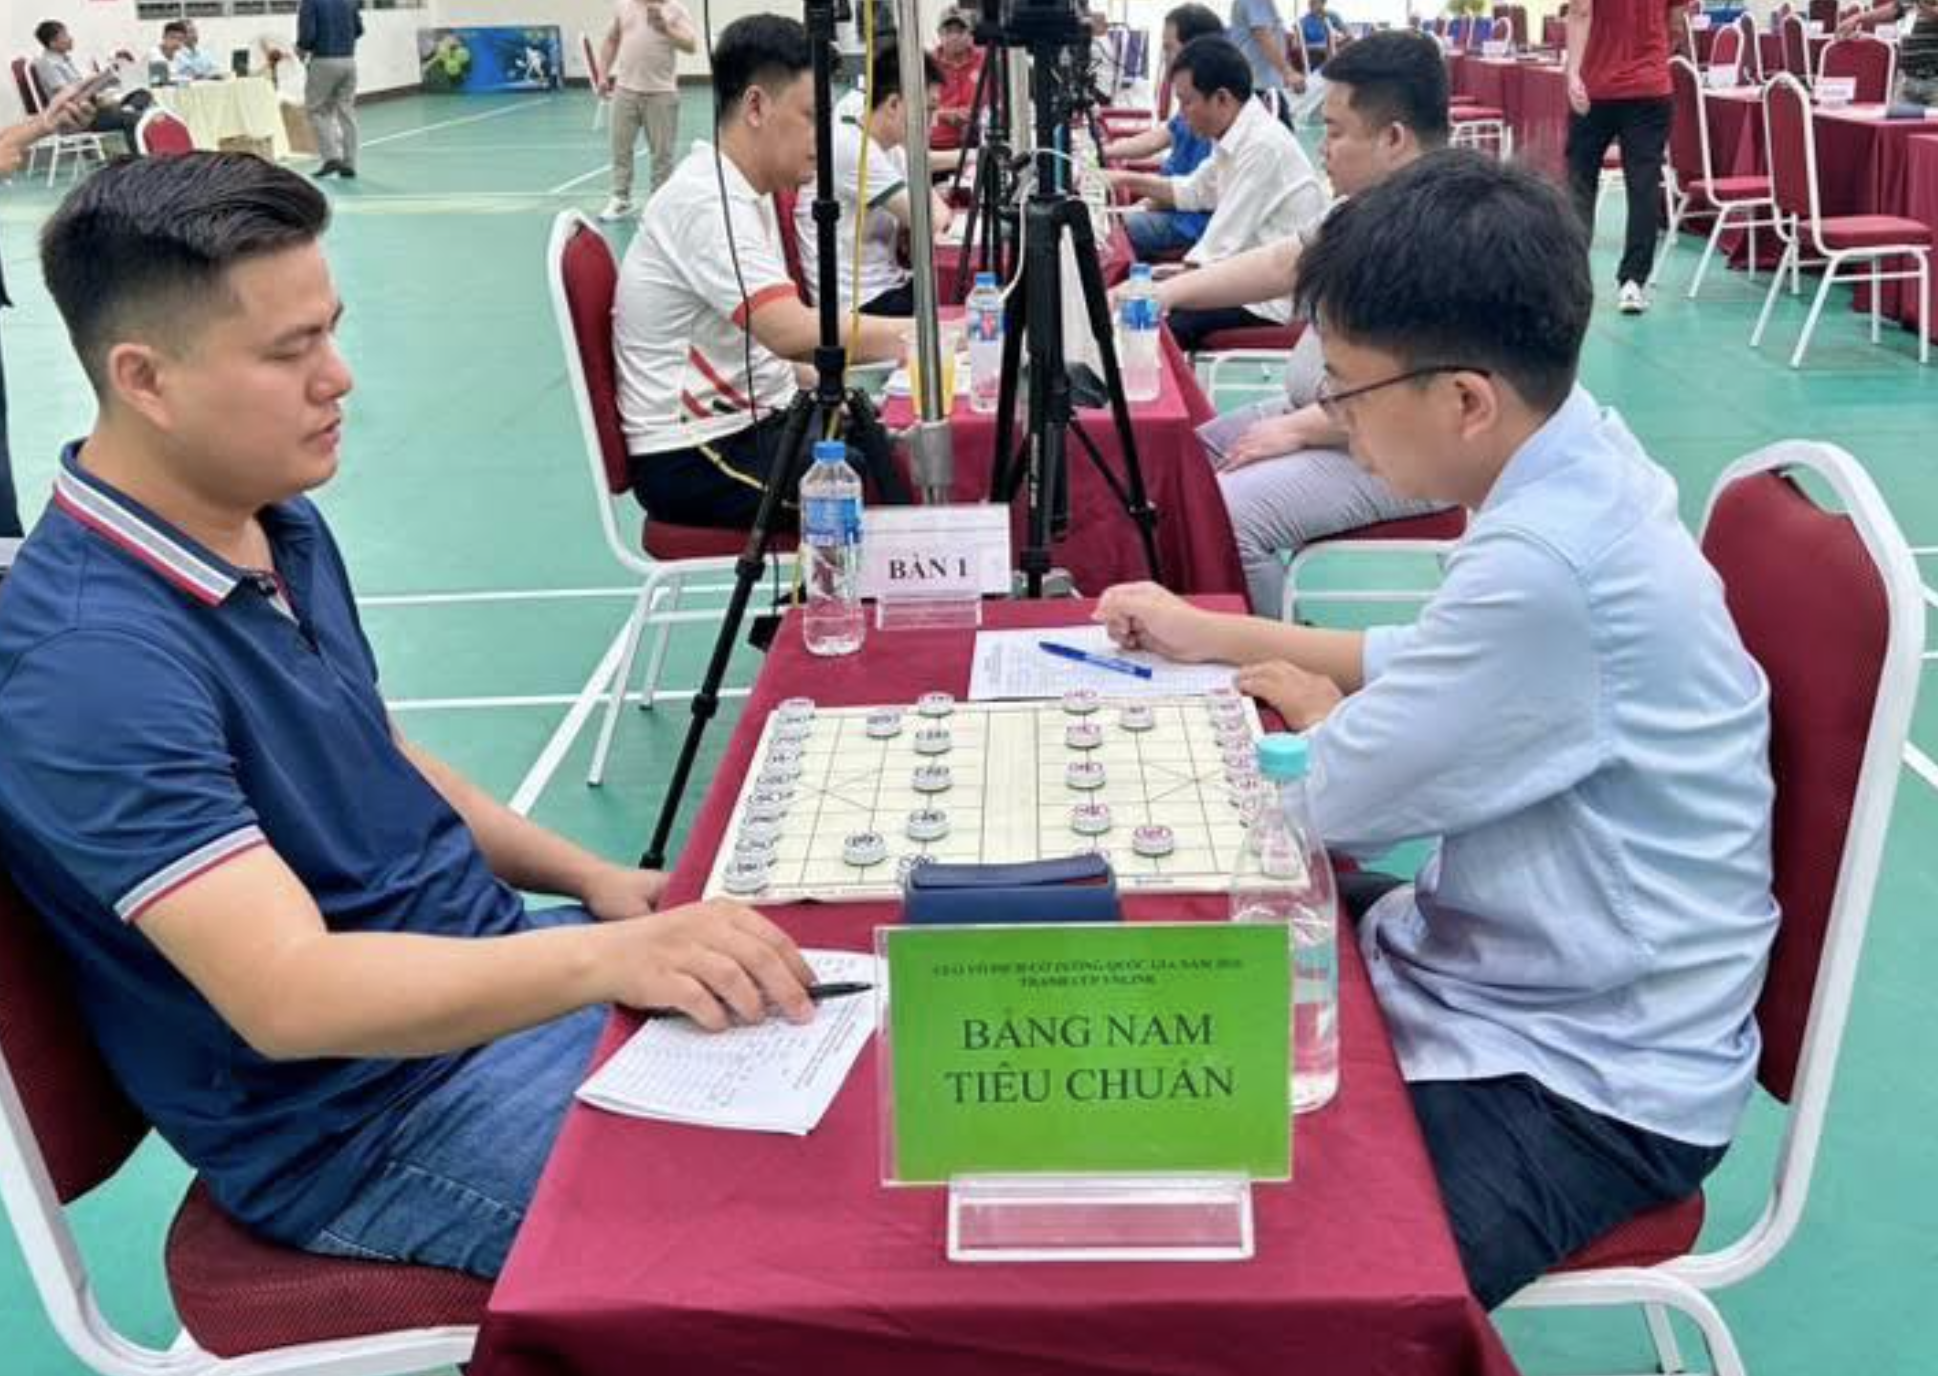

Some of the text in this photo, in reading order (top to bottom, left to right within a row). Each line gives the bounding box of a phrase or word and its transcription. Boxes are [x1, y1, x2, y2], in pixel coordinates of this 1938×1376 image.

[958, 558, 967, 578] 1
[963, 1007, 1212, 1051] BẢNG NAM
[944, 1061, 1051, 1104] TIÊU
